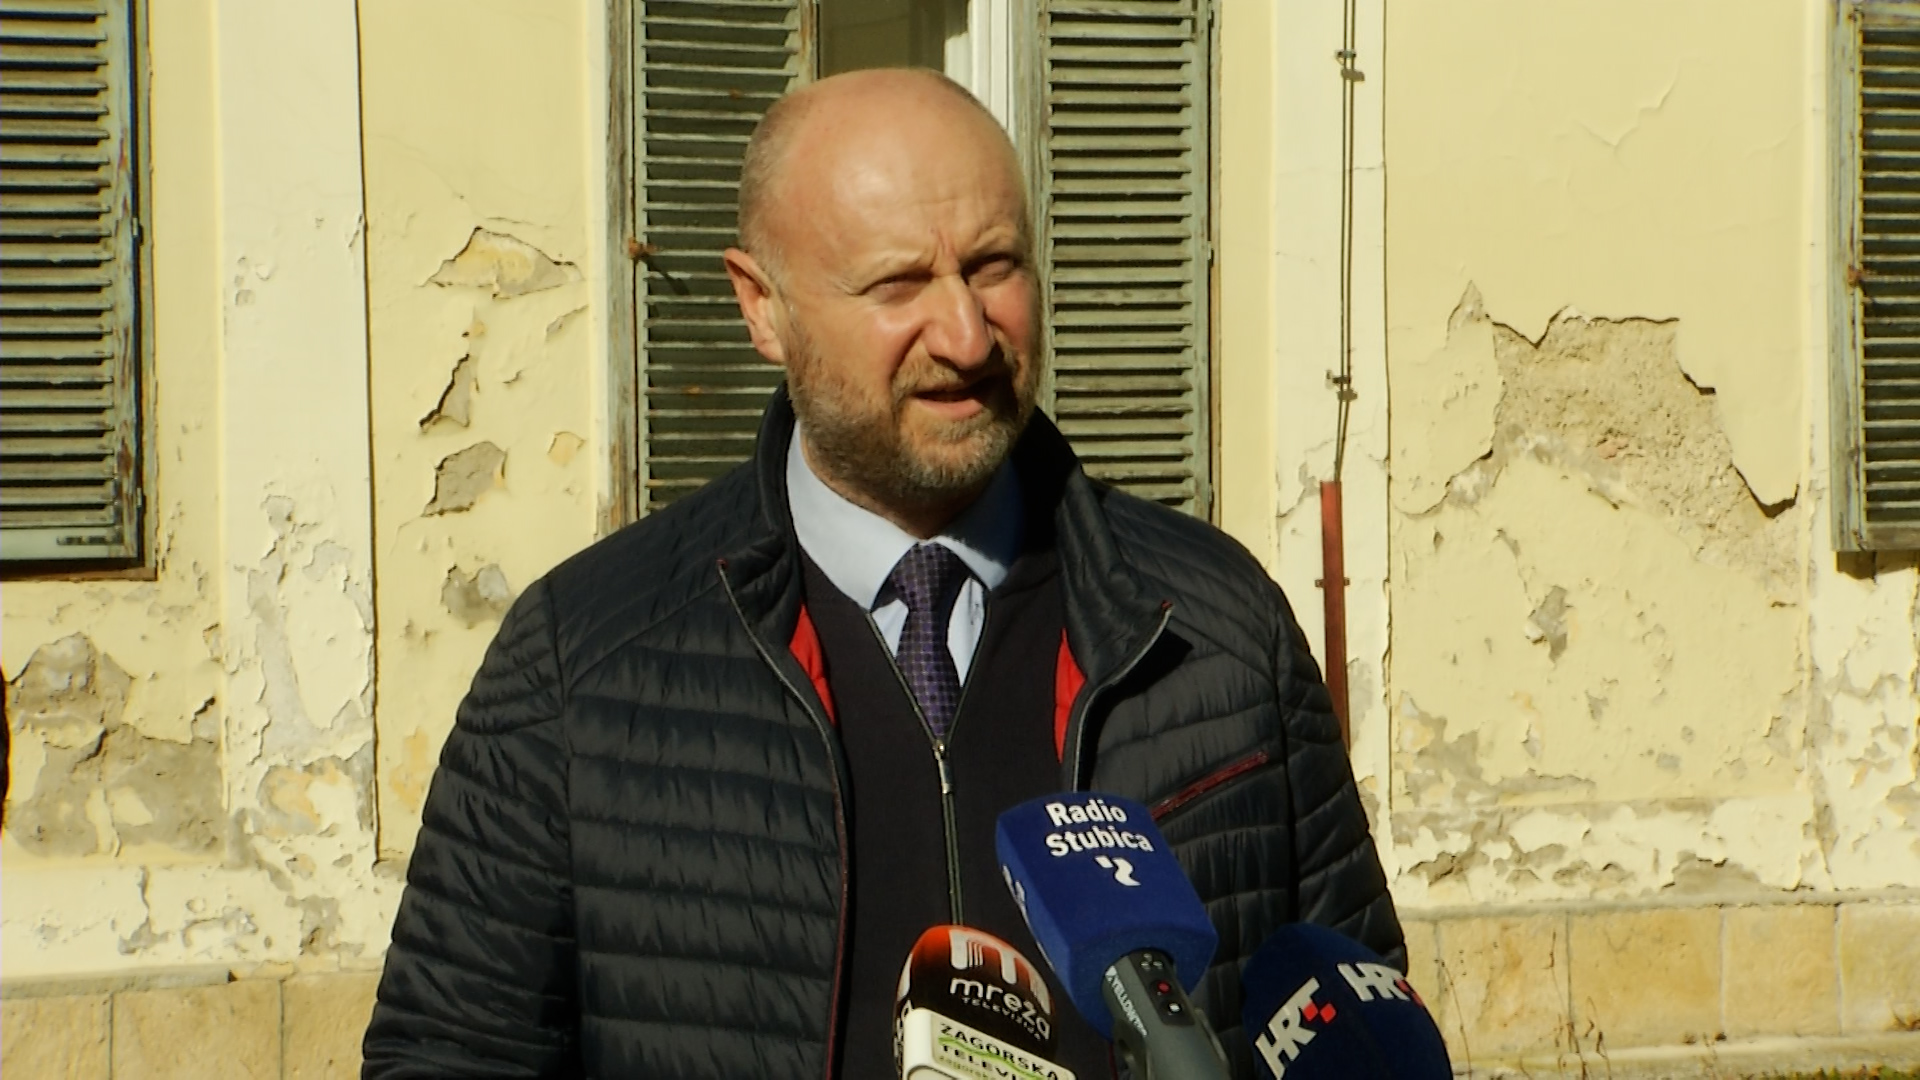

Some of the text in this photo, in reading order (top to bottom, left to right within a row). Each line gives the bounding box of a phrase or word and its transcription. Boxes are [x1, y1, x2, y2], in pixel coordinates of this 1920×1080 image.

[1046, 799, 1128, 826] Radio
[1046, 826, 1154, 857] Stubica
[1254, 976, 1320, 1080] HRT
[940, 1022, 1058, 1080] ZAGORSKA
